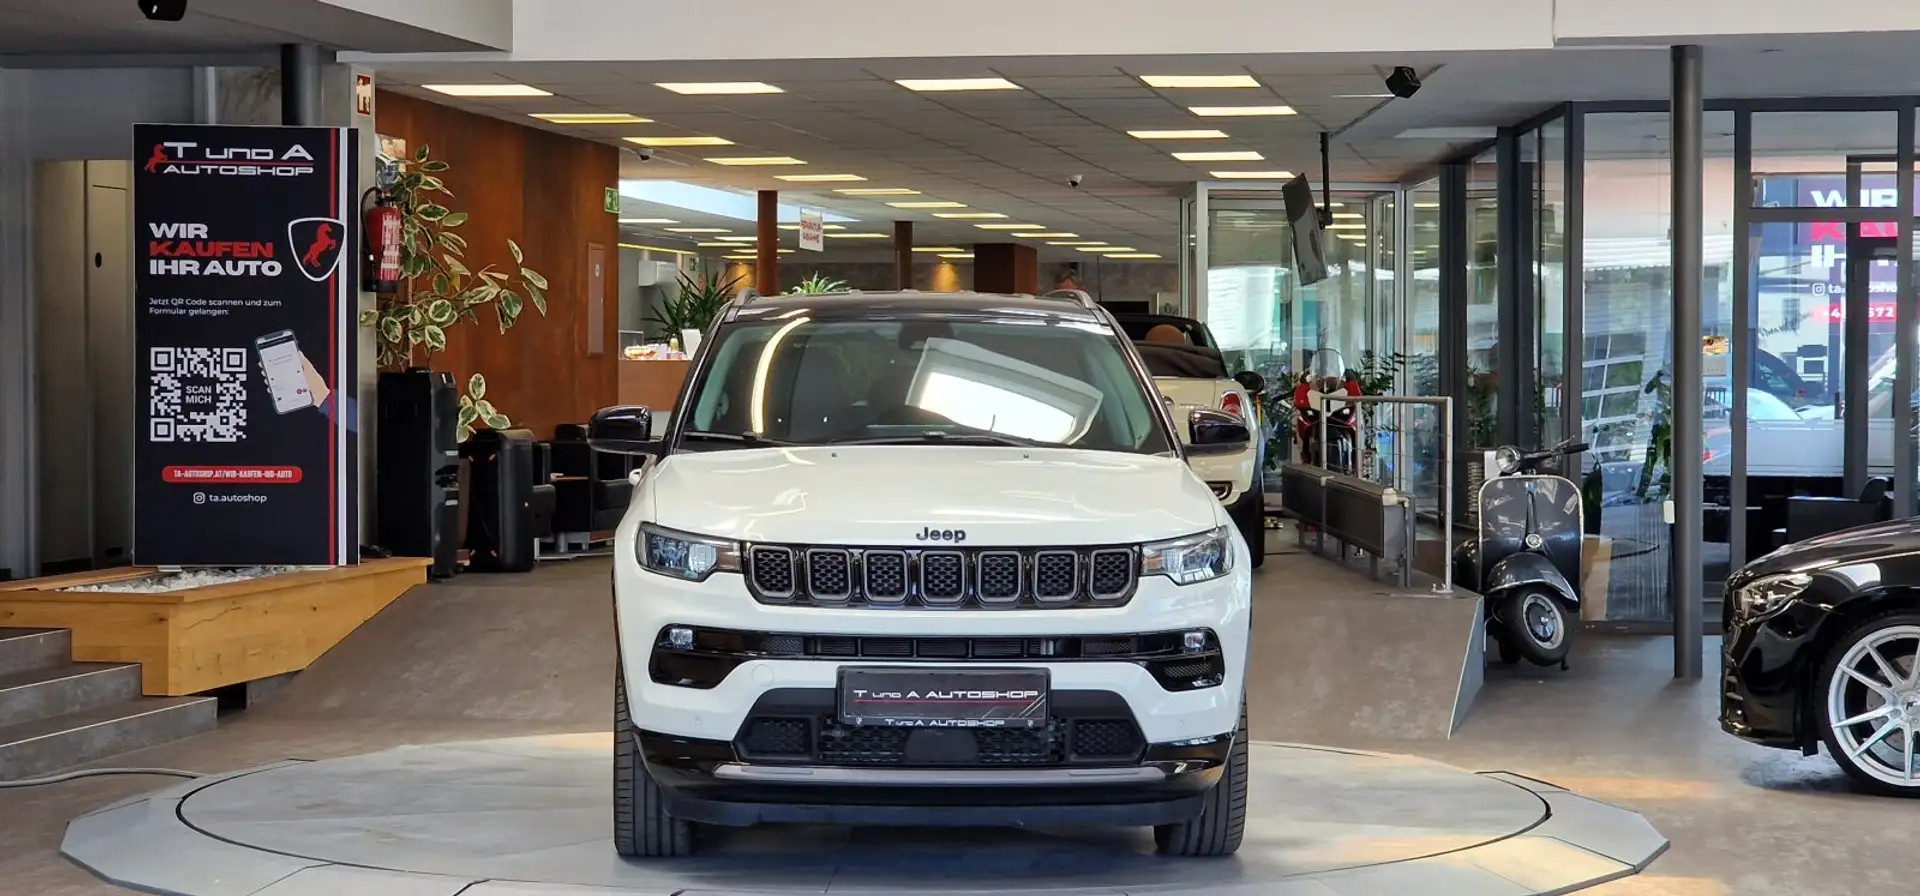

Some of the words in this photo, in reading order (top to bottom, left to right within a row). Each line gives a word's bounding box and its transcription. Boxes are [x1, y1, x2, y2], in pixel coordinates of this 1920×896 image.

[164, 141, 197, 159] T
[280, 144, 314, 161] A
[163, 164, 314, 177] AUTOSHOP
[149, 223, 208, 239] WIR
[149, 241, 274, 258] KAUFEN
[149, 260, 200, 276] IHR
[203, 260, 283, 277] AUTO
[149, 298, 169, 306] Jetzt
[170, 298, 184, 307] QR
[185, 298, 208, 306] Code
[149, 307, 187, 315] Formular
[188, 308, 230, 317] gelangen:
[186, 386, 212, 394] SCAN
[186, 395, 212, 404] MICH
[209, 493, 267, 504] ta.autoshop
[916, 526, 966, 543] Jeep
[853, 690, 867, 698] T
[906, 690, 920, 699] A
[925, 690, 1039, 699] AUTOSHOP
[884, 718, 896, 726] T
[913, 719, 924, 727] A
[929, 719, 1006, 727] AUTOSHOP
